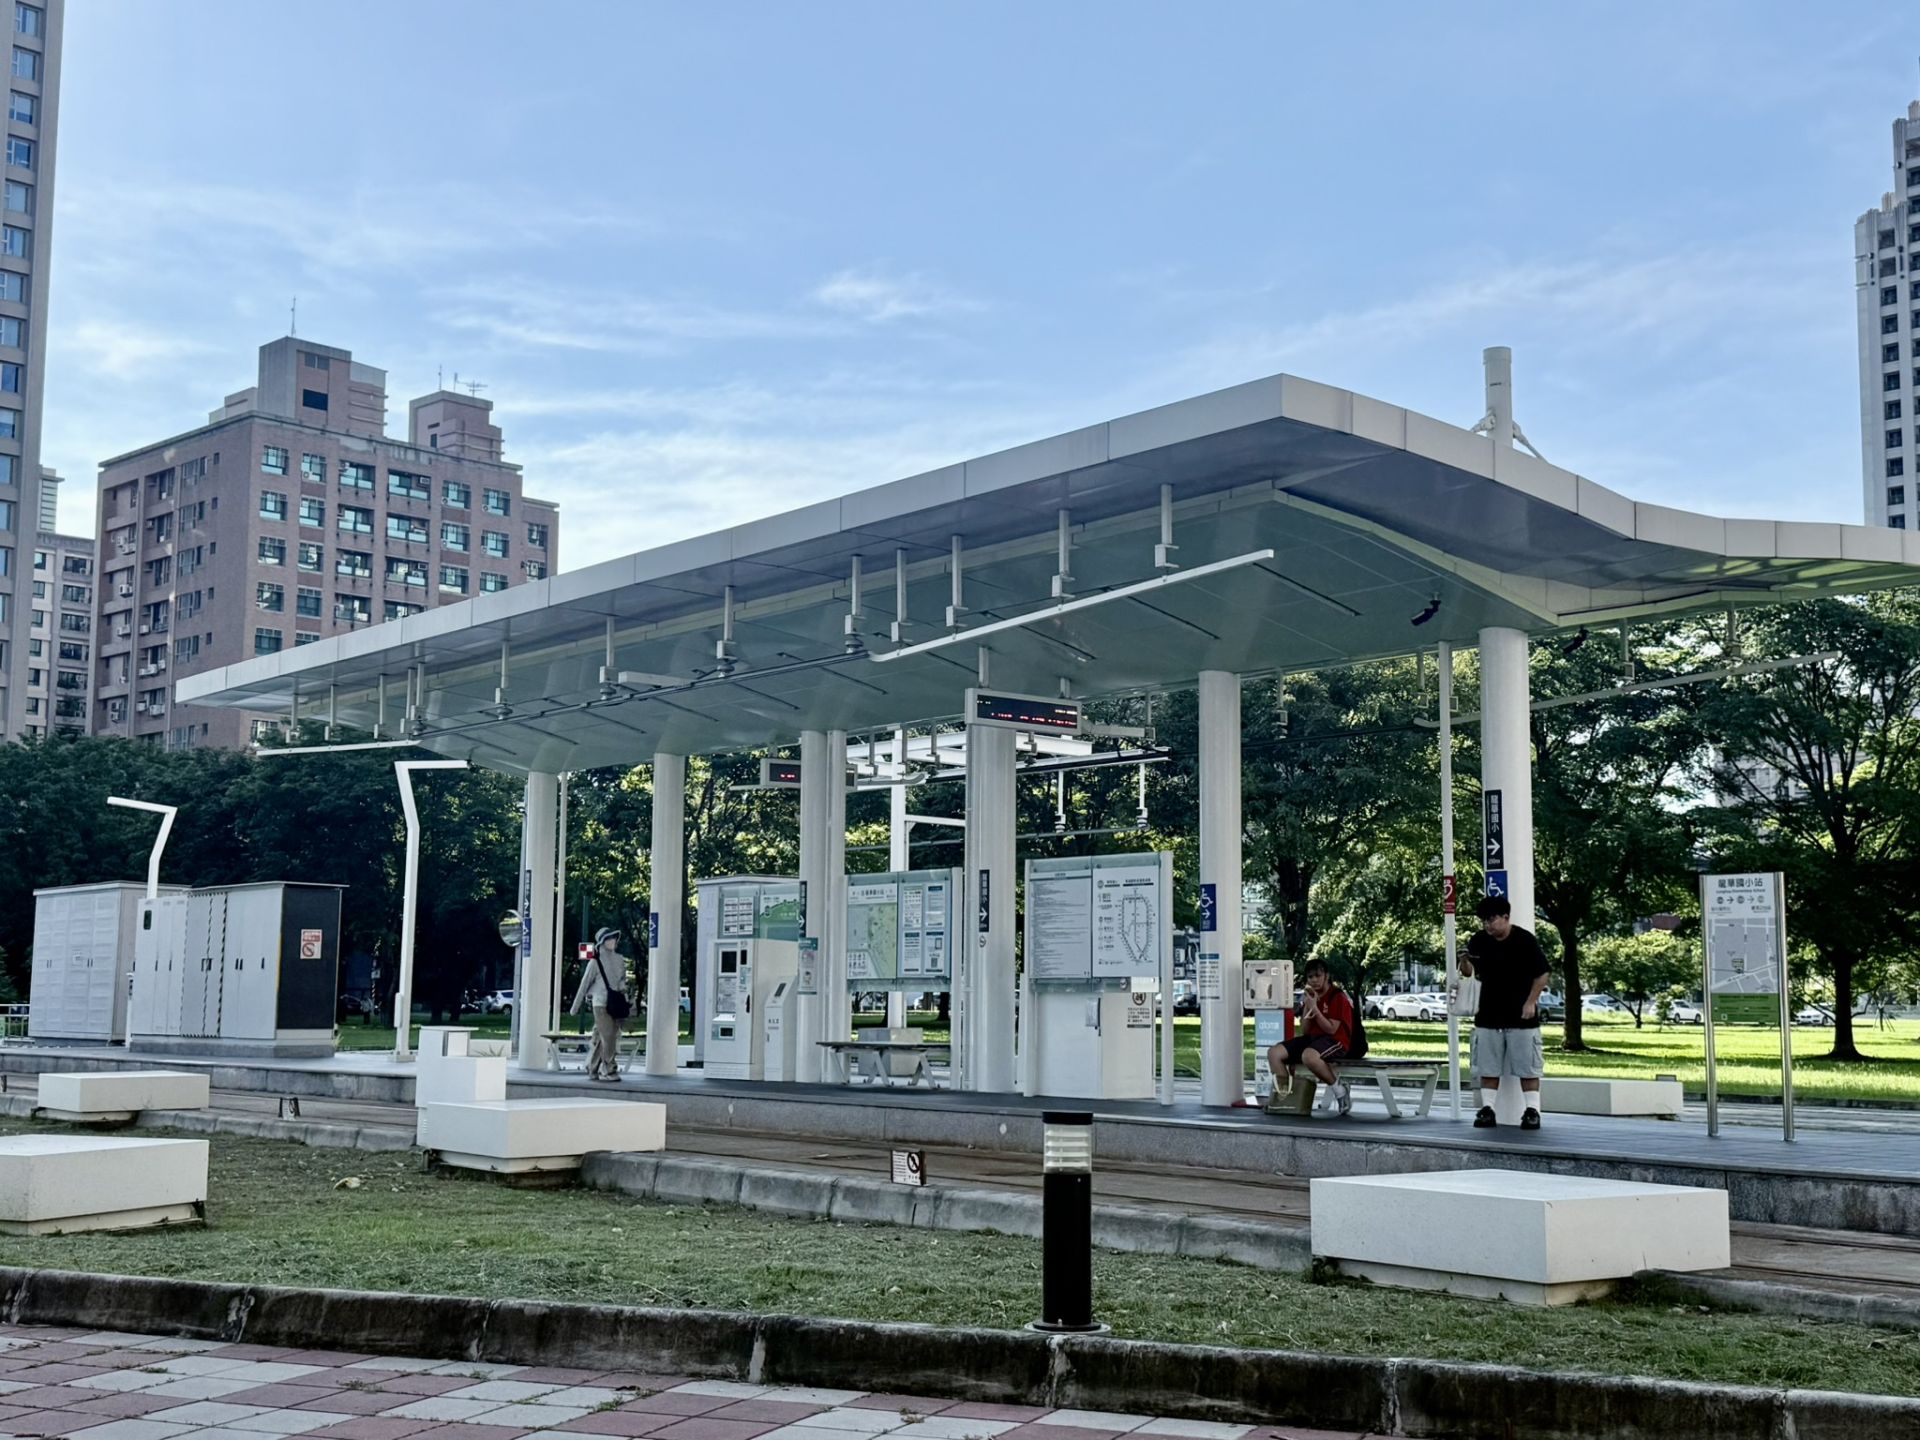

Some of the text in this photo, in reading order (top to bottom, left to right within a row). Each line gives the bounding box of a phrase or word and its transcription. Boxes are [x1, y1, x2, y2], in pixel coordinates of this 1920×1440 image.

[1718, 878, 1763, 888] 龍華國小站
